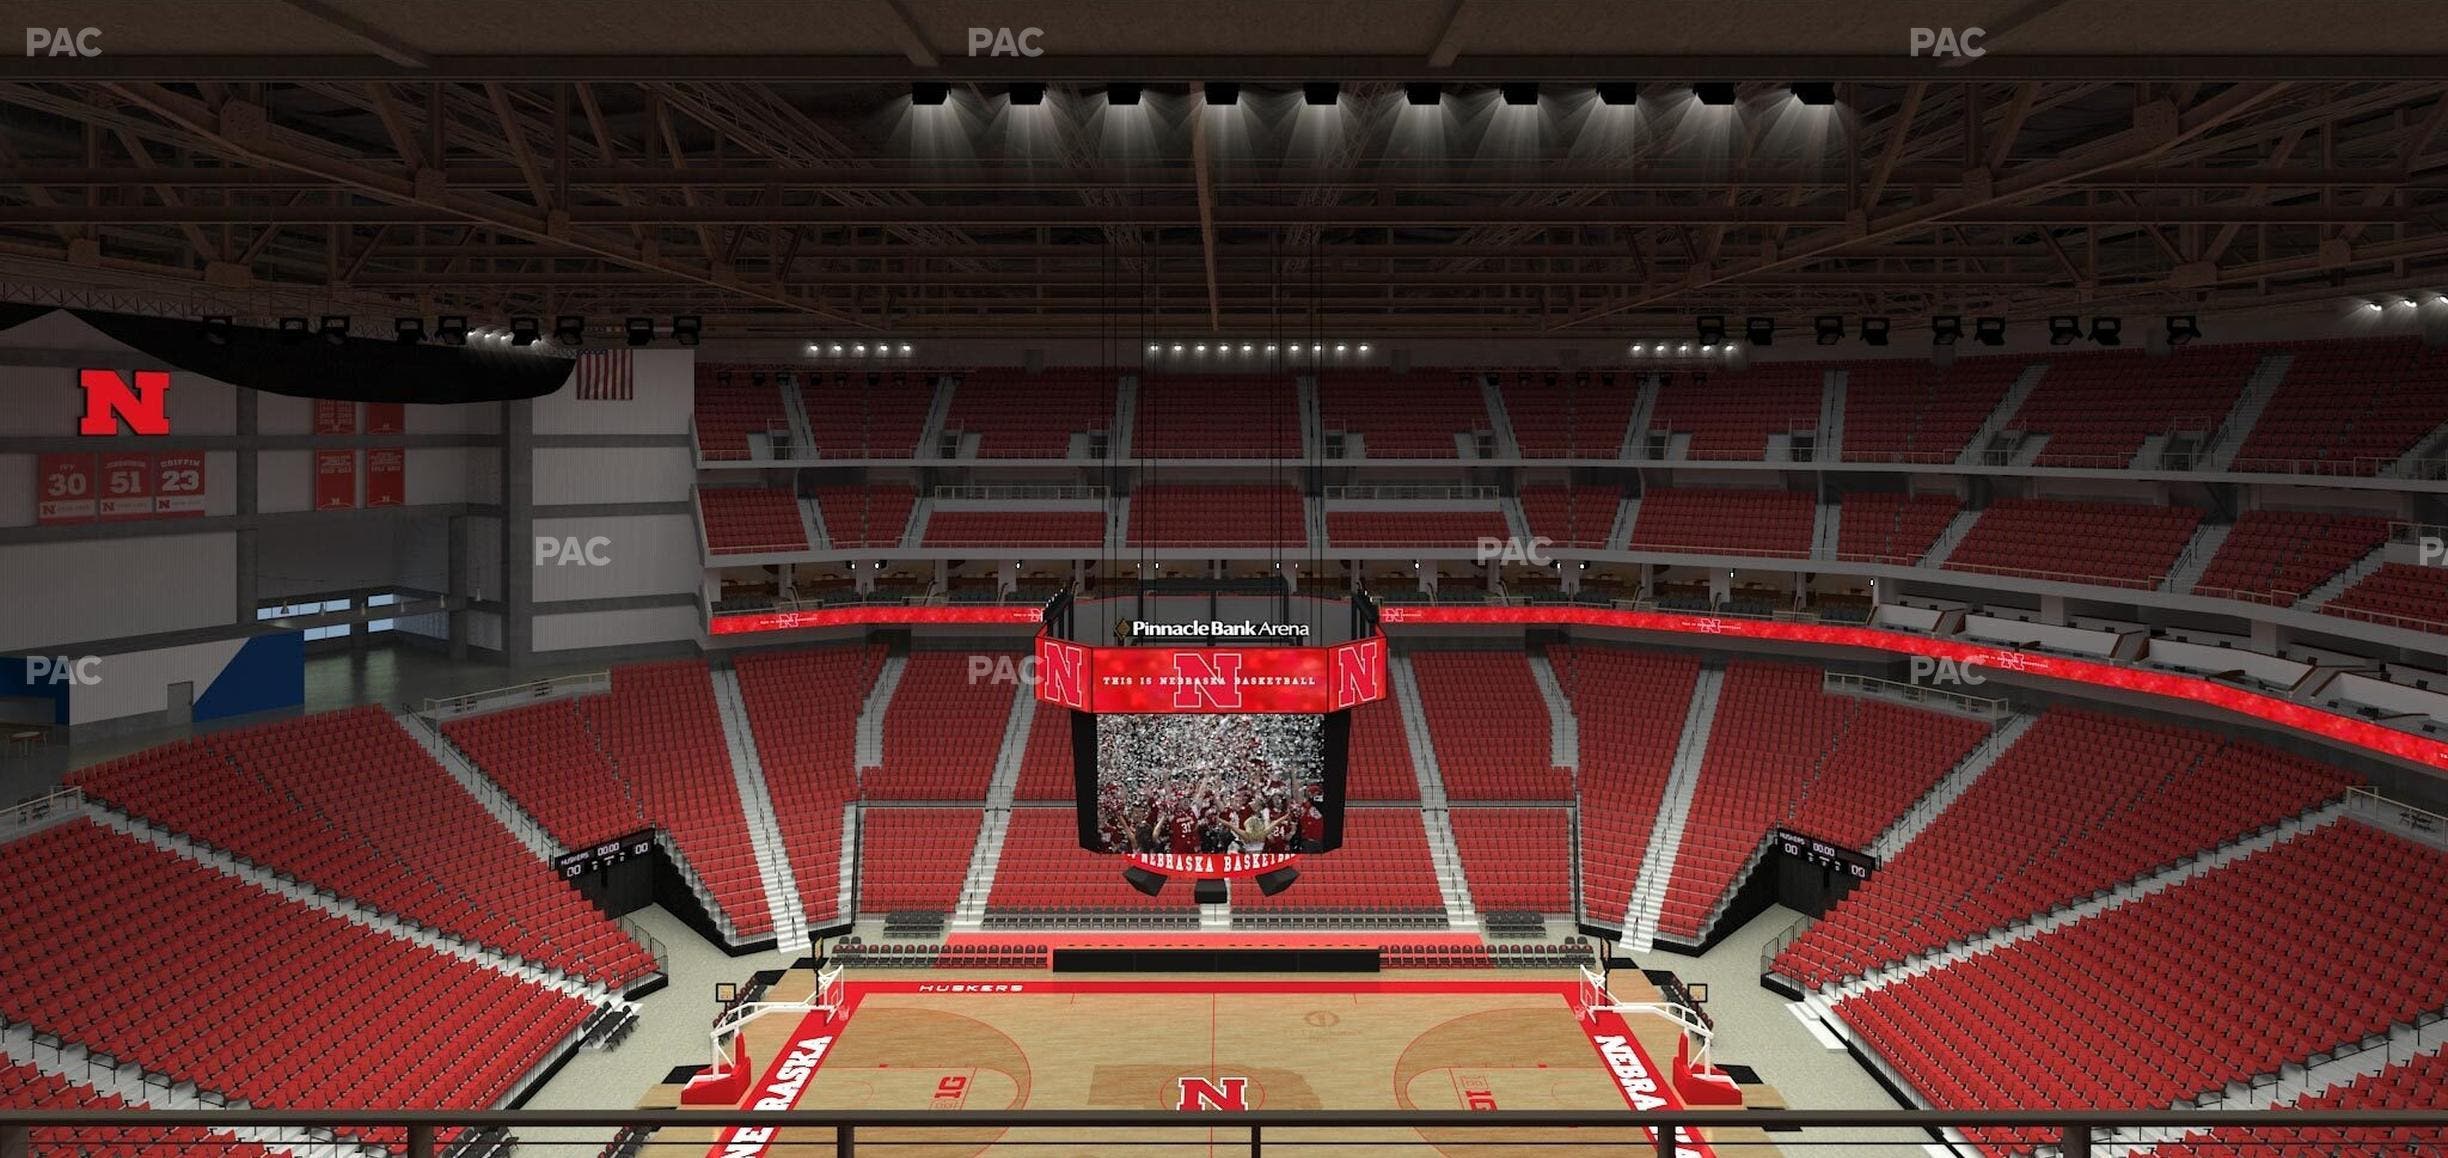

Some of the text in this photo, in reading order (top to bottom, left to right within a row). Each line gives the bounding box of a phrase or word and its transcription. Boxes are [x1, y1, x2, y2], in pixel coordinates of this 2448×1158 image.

[80, 369, 170, 435] N
[48, 473, 86, 496] 30
[110, 471, 141, 494] 51
[162, 470, 199, 492] 23
[1133, 620, 1309, 636] Pinnacle Bank Arena
[1044, 641, 1082, 707] N
[1103, 676, 1316, 685] THIS IS NEBRASKA BASKETBALL
[1173, 653, 1241, 708] N
[1338, 641, 1376, 707] N
[635, 842, 648, 854] 00
[1785, 843, 1798, 855] 00
[567, 865, 580, 877] 00
[1141, 854, 1214, 872] NEBRASKA
[1851, 865, 1866, 878] 00
[919, 984, 1023, 993] HUSKERS
[720, 1036, 833, 1158] NERASKA
[1175, 1077, 1248, 1111] N
